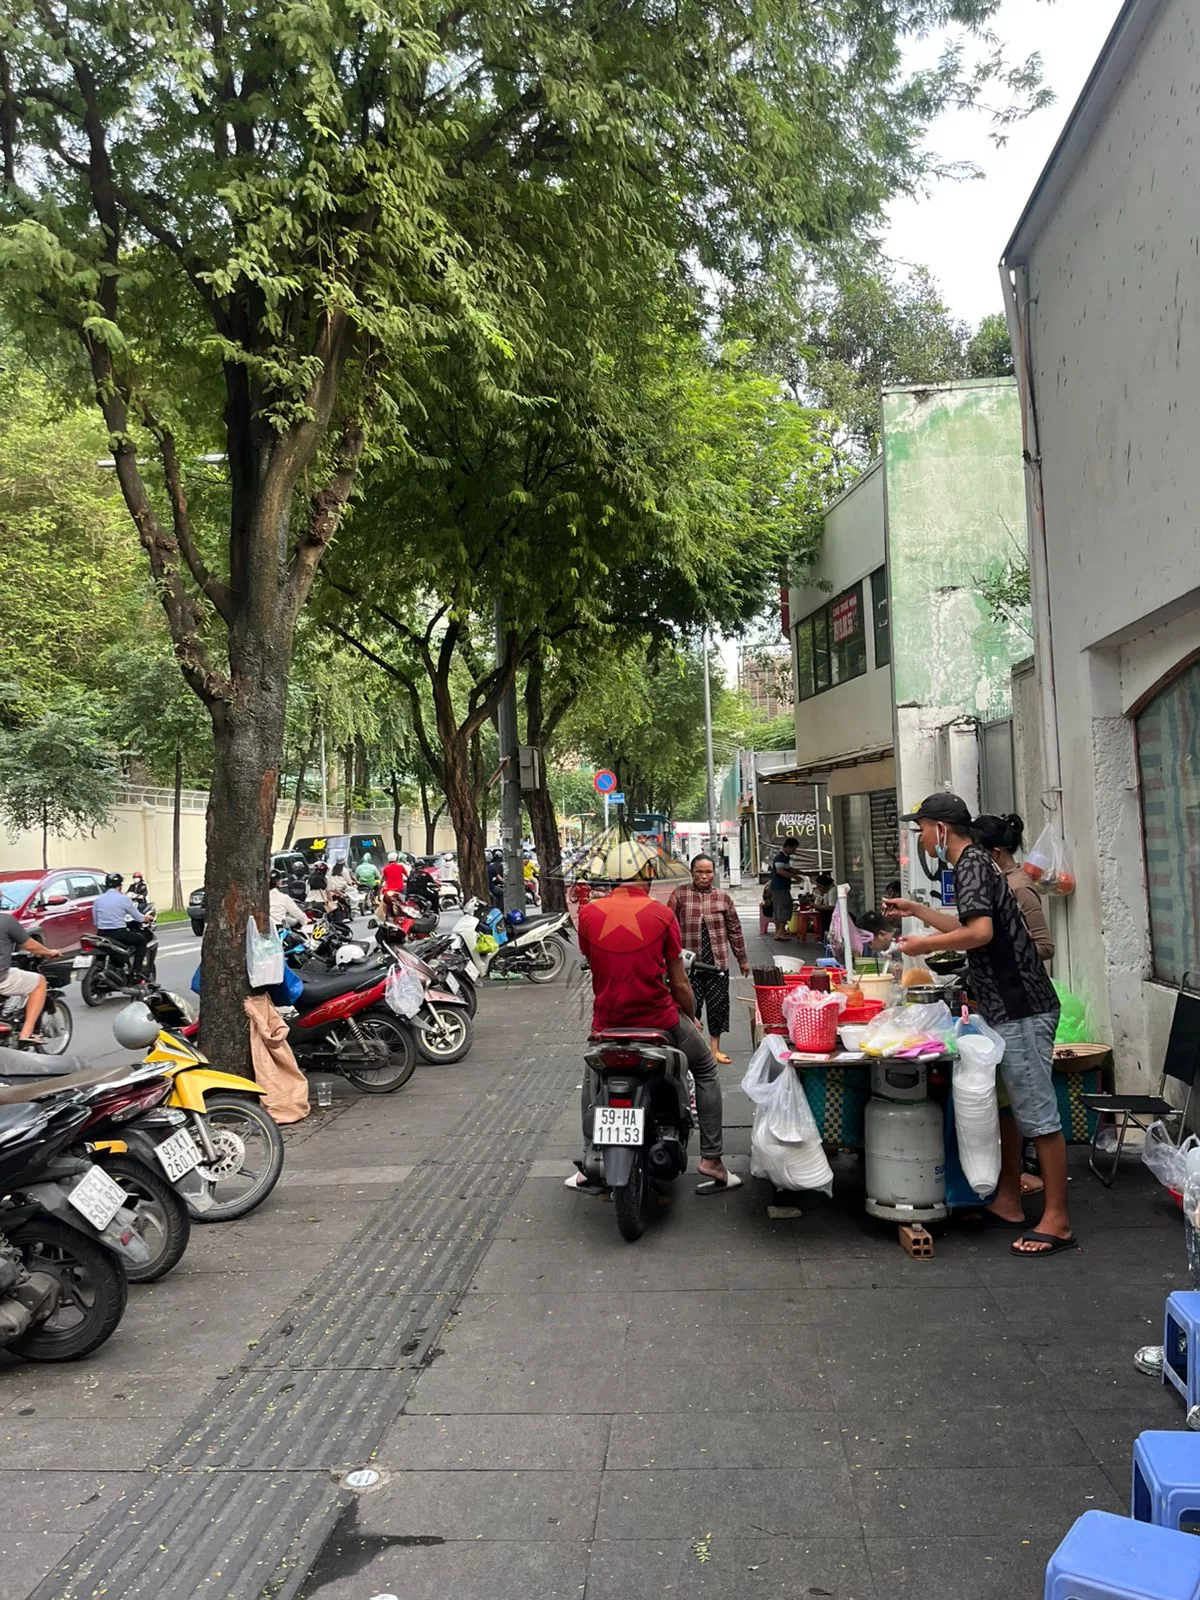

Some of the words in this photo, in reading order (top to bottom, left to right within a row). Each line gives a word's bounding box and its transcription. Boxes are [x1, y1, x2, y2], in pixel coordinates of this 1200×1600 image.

[601, 1109, 636, 1126] 59-HA
[598, 1126, 640, 1143] 111.53
[162, 1133, 189, 1159] 93-K1
[167, 1146, 200, 1178] 260.17
